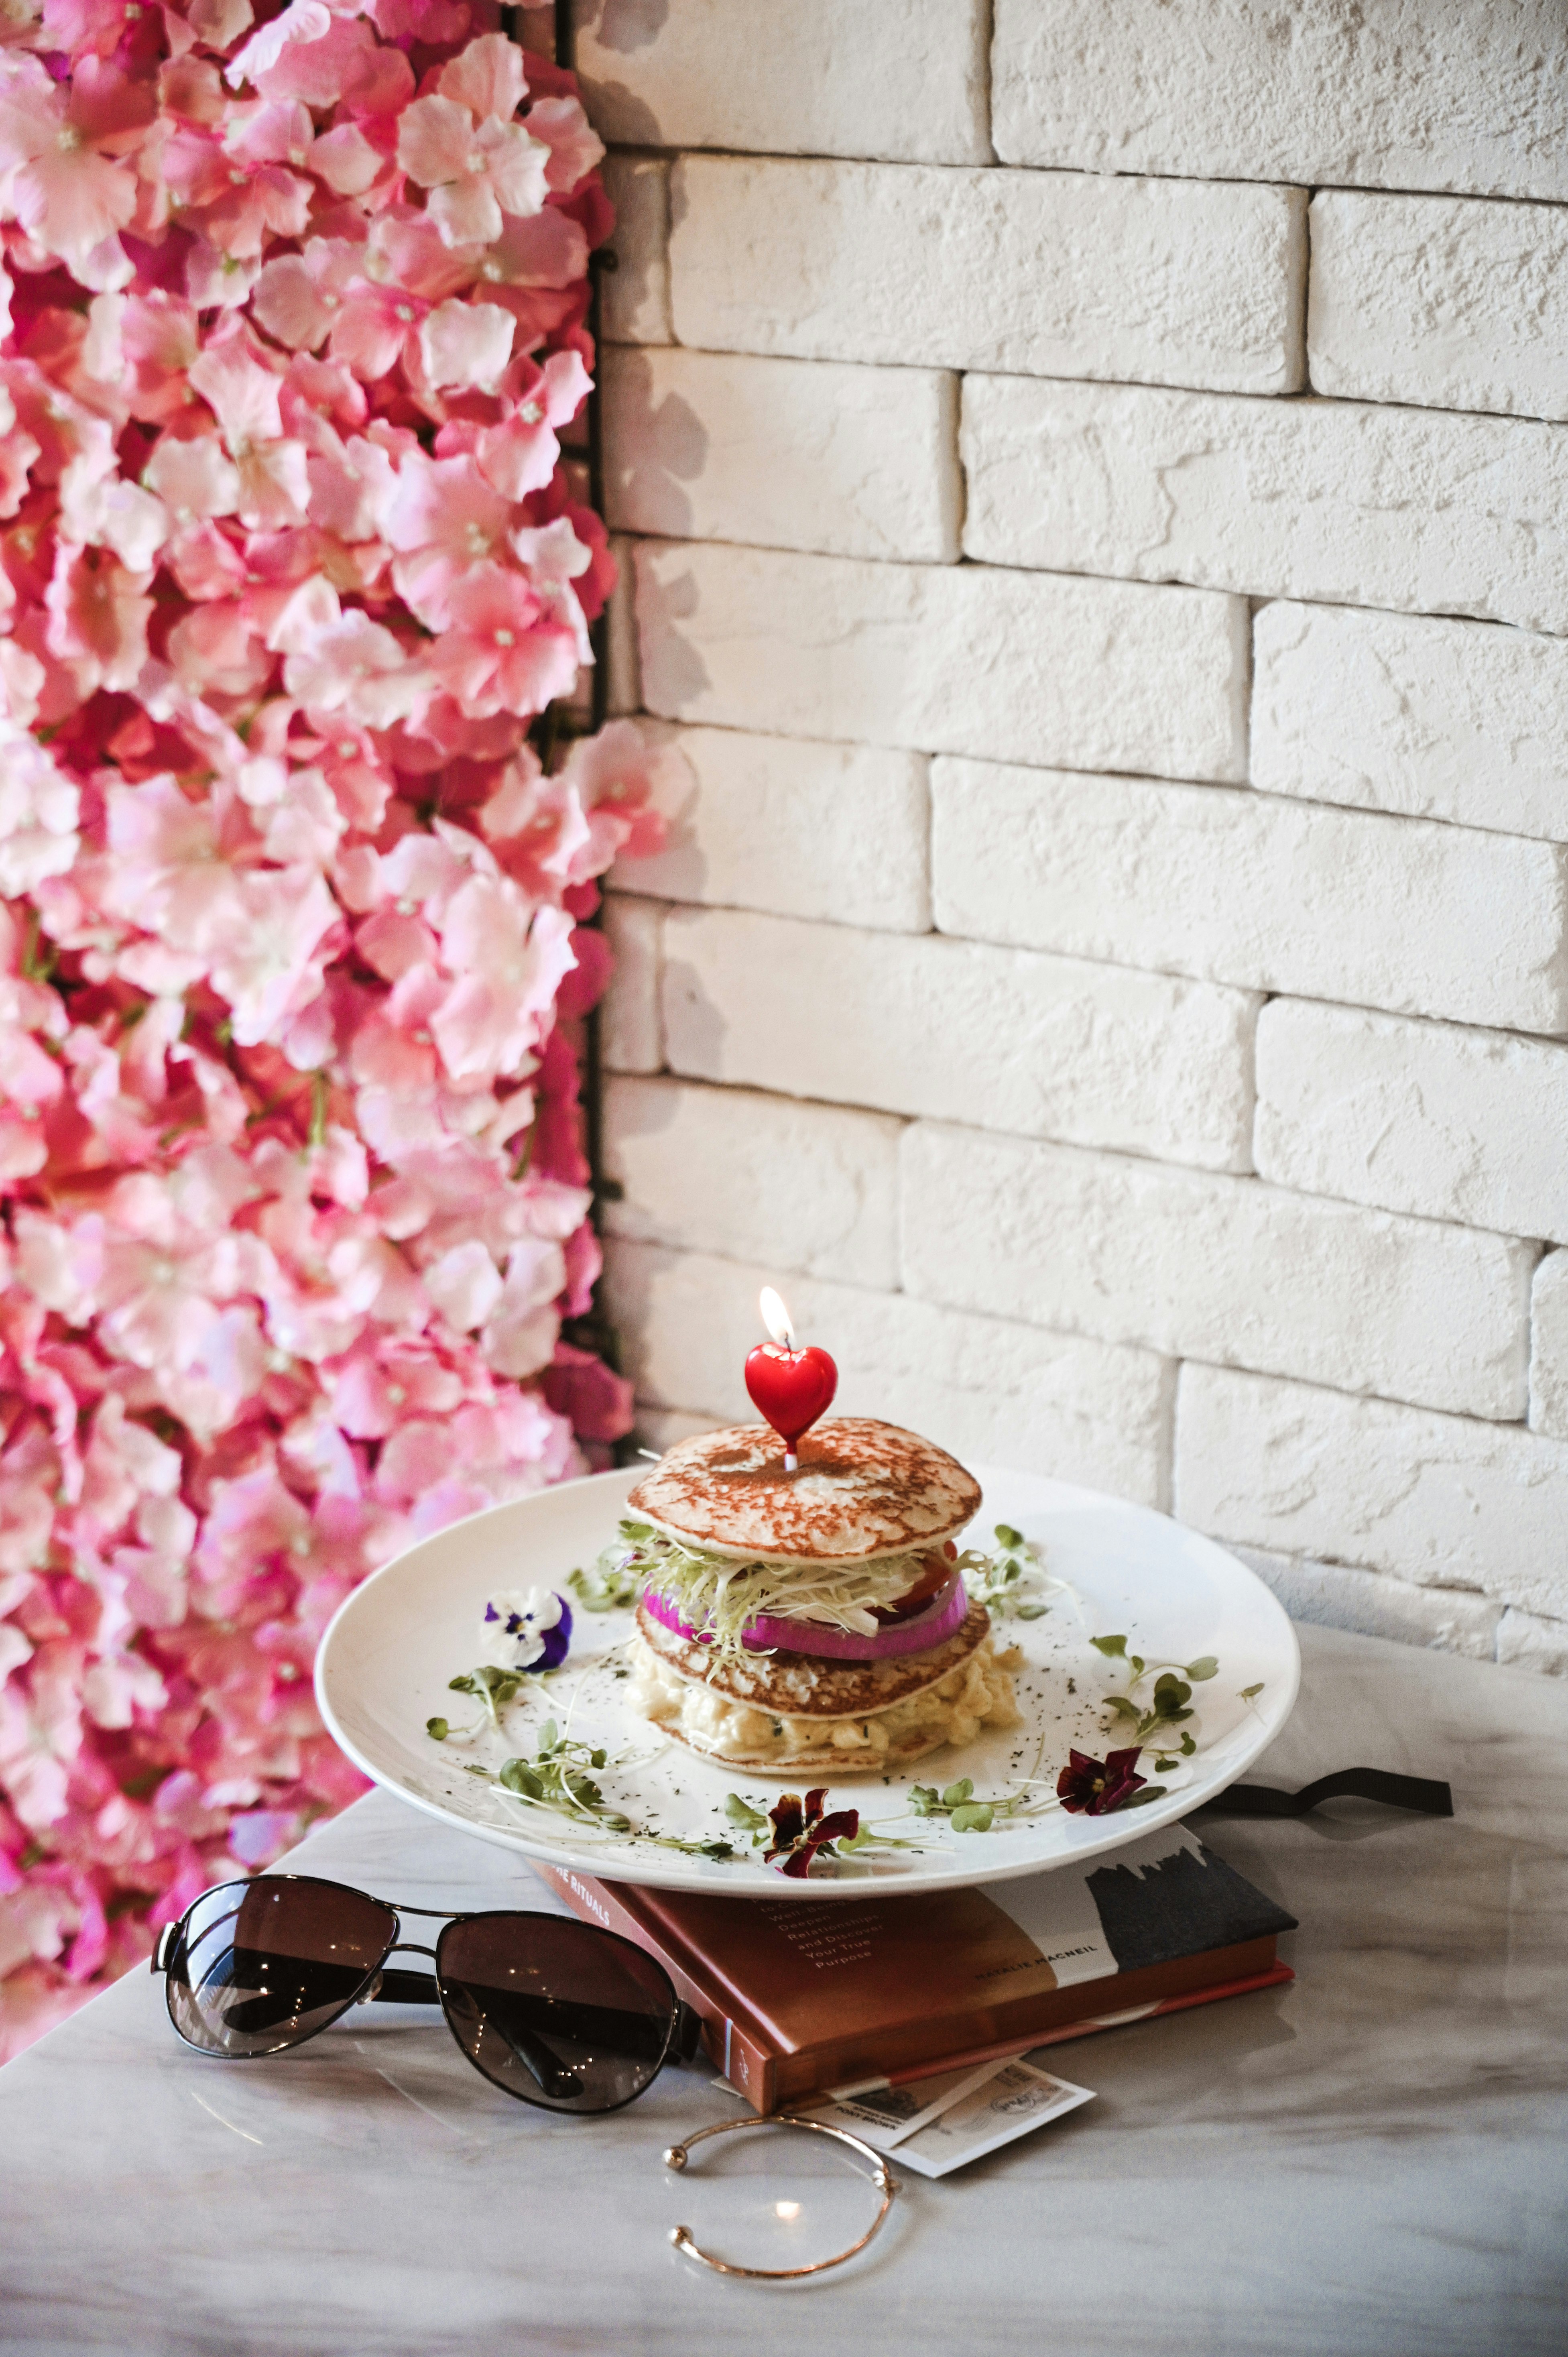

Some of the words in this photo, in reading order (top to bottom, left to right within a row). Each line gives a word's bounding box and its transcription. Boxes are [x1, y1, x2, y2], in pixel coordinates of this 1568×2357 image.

[552, 1866, 569, 1883] HE
[571, 1876, 609, 1926] RITUALS
[779, 1915, 831, 1931] Deepen
[799, 1940, 822, 1950] and
[826, 1925, 884, 1942] Discover
[806, 1948, 836, 1959] Your
[840, 1940, 870, 1950] True
[816, 1952, 872, 1968] Purpose
[975, 1962, 1033, 1980] NATALIE
[1035, 1946, 1098, 1964] MACNEIL
